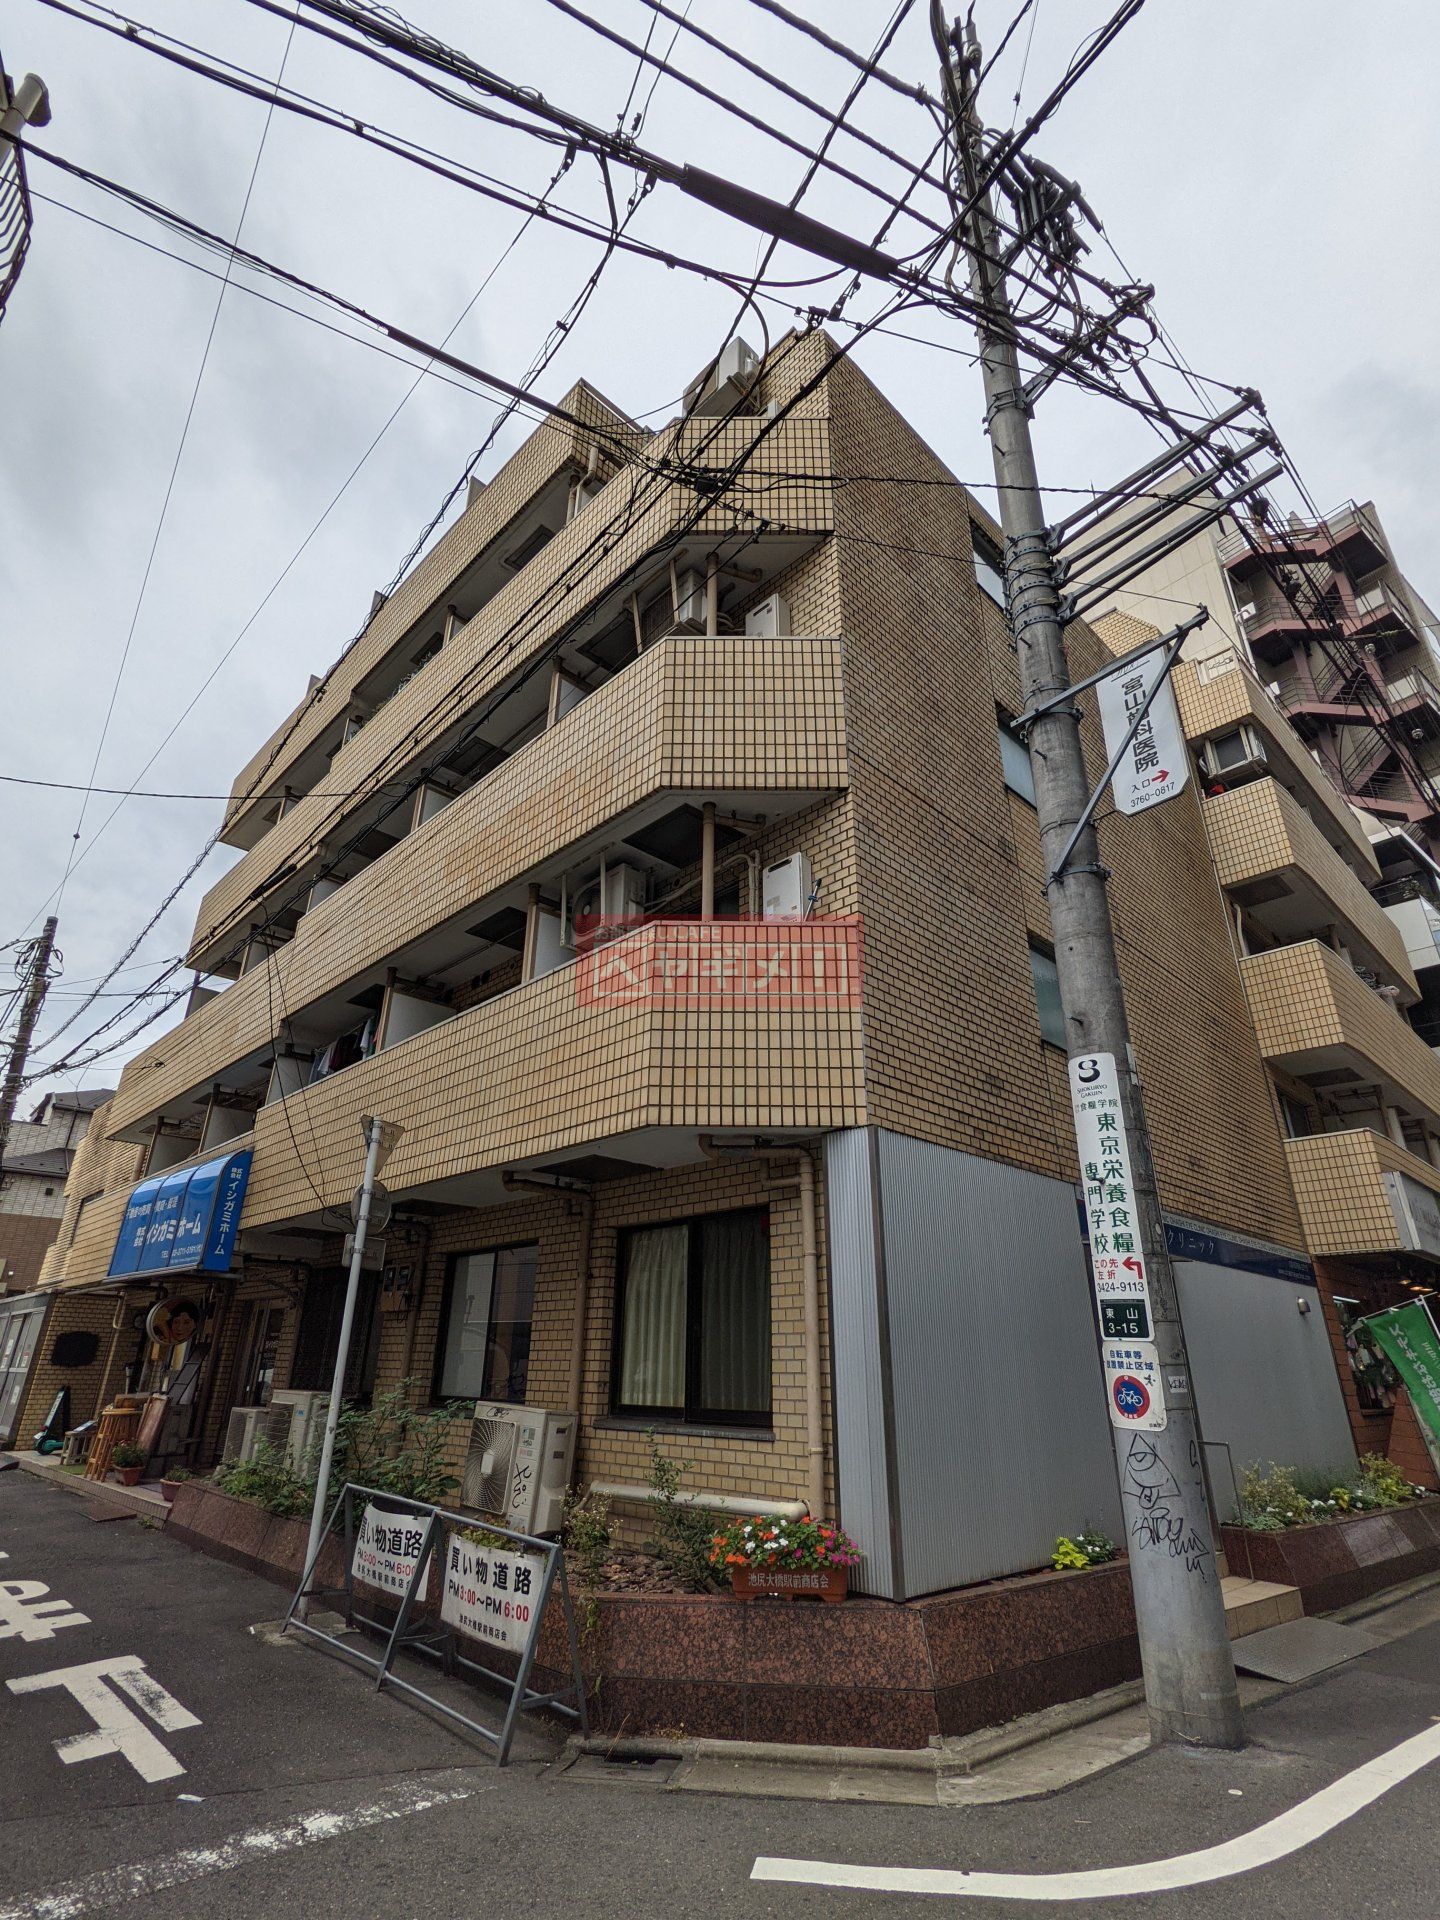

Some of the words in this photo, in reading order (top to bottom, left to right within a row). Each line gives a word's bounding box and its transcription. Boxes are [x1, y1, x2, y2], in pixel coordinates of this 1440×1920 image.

[1131, 778, 1150, 793] 入口
[1130, 781, 1175, 808] 3760-0817
[1076, 1084, 1108, 1094] SHOKURYO
[1080, 1090, 1103, 1098] GAKUIN
[1096, 1112, 1136, 1253] 東京栄養食糧
[1084, 1162, 1111, 1255] 専門学校
[214, 1181, 239, 1255] イシガミホーム
[146, 1213, 201, 1245] イシガミホーム
[1167, 1230, 1215, 1255] クリニック
[1094, 1258, 1119, 1269] この先
[1097, 1269, 1117, 1280] 左折
[1097, 1281, 1145, 1293] 3424-9113
[1105, 1307, 1139, 1319] 東山
[1108, 1322, 1139, 1334] 3-15
[1109, 1349, 1143, 1359] 自転車等
[359, 1516, 424, 1559] 買い物道路
[450, 1546, 532, 1596] 買い物道路
[748, 1573, 829, 1589] 池尻大橋駅前商店会
